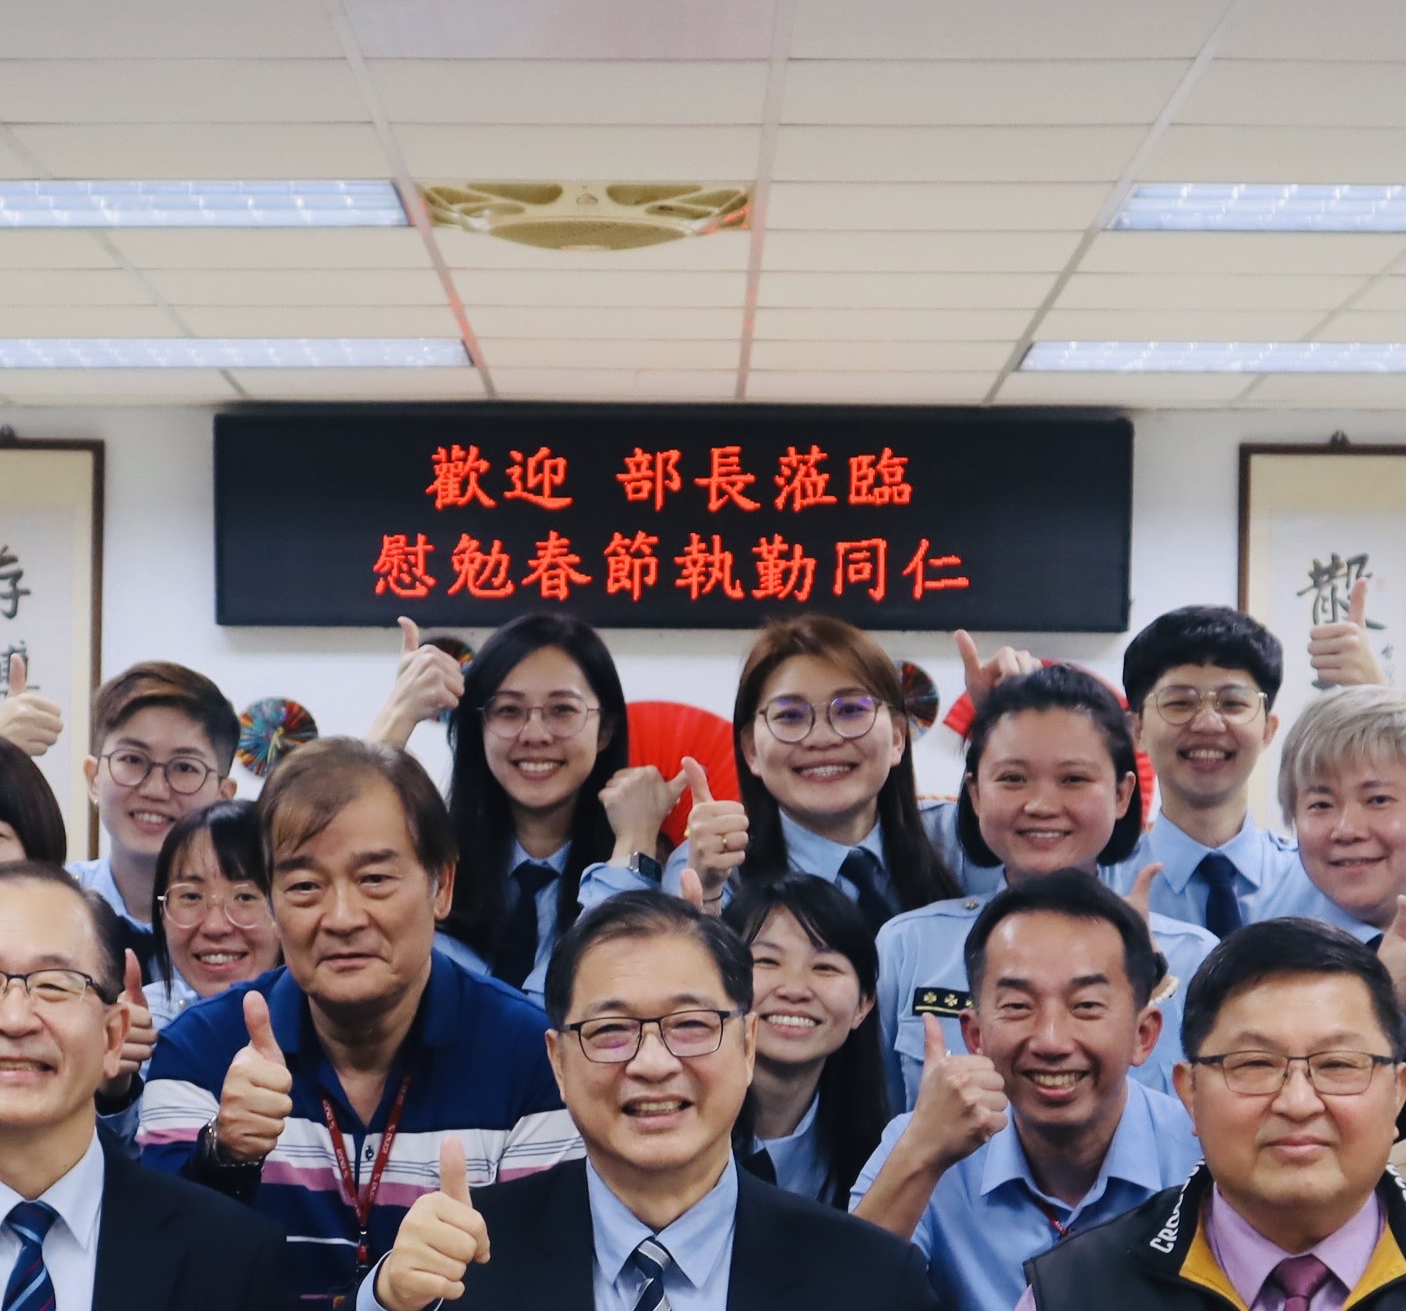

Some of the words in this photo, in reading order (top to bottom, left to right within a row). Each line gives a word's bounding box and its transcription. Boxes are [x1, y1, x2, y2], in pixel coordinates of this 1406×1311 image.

[425, 445, 574, 512] 歡迎
[616, 445, 912, 512] 部長蒞臨
[373, 531, 970, 602] 慰勉春節執勤同仁
